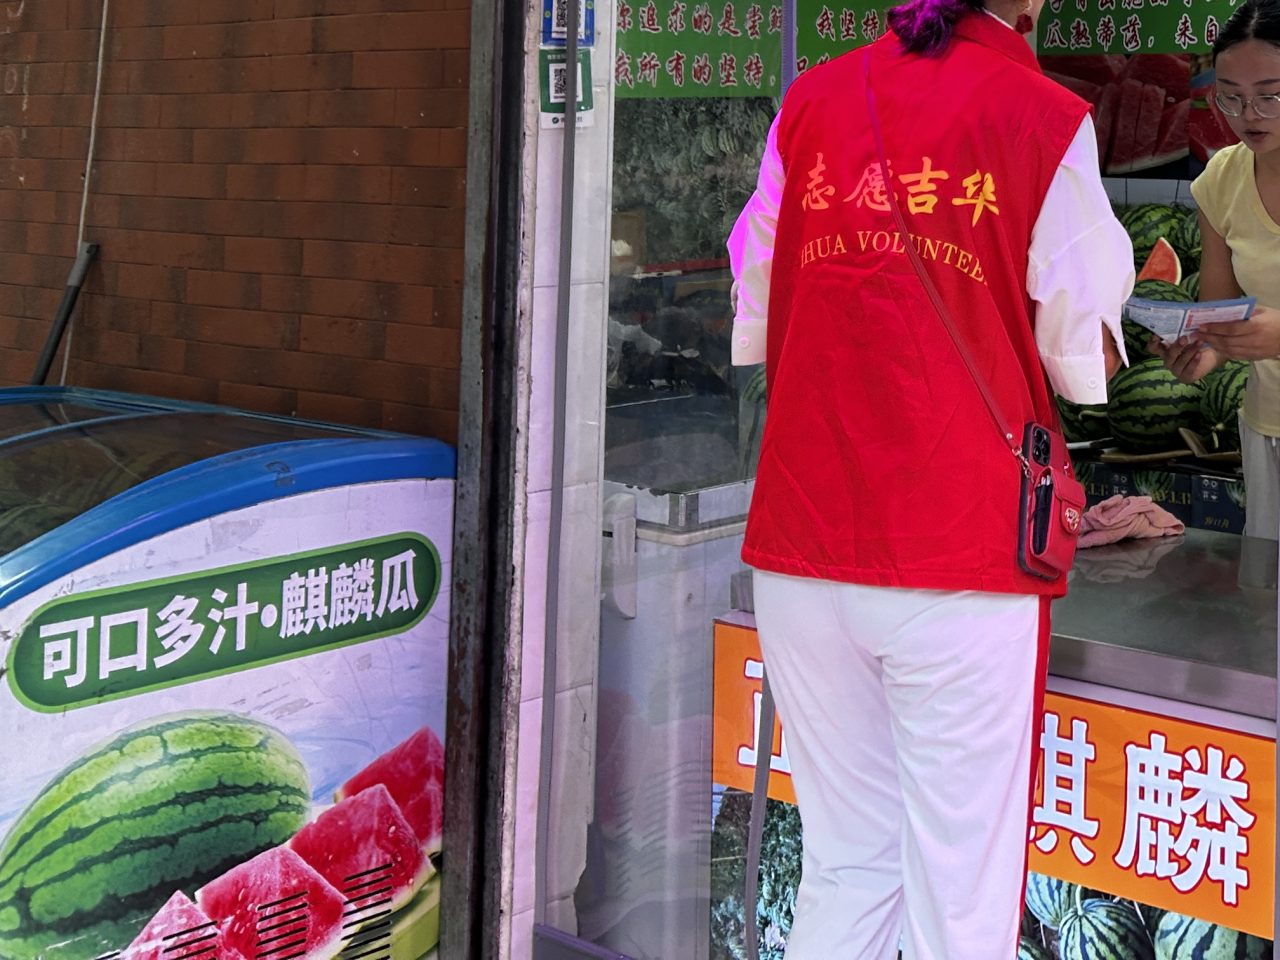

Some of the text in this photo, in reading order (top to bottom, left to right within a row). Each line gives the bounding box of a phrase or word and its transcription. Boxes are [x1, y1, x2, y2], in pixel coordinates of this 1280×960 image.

[802, 152, 999, 227] 志愿吉华
[857, 230, 988, 286] VOLUNTEE
